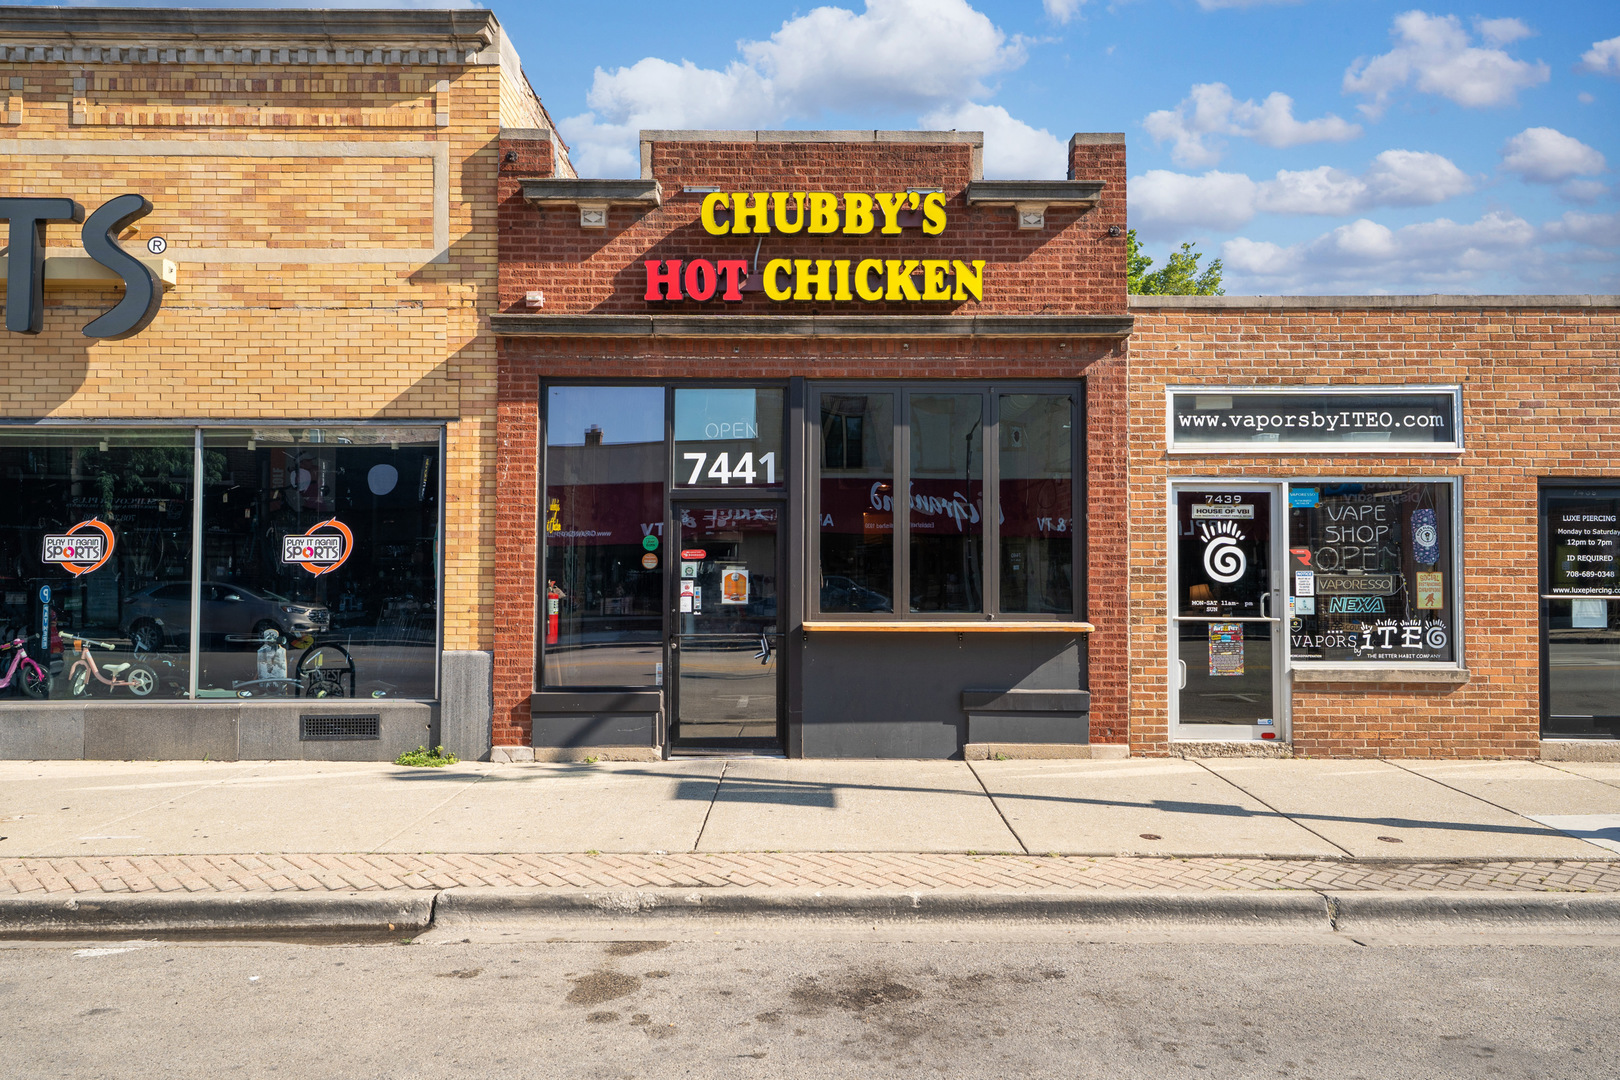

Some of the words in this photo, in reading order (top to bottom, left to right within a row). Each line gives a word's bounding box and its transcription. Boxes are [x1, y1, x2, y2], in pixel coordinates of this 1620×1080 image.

[701, 191, 947, 236] CHUBBY'S
[644, 259, 749, 302] HOT
[763, 258, 987, 302] CHICKEN
[1178, 411, 1445, 431] www.vaporsbyITEO.com
[705, 422, 758, 438] OPEN
[683, 452, 775, 484] 7441
[1205, 495, 1242, 504] 7439
[1327, 504, 1386, 521] VAPE
[1325, 525, 1389, 543] SHOP
[1557, 528, 1582, 536] Monday
[1592, 528, 1620, 536] Saturday
[47, 546, 100, 559] SPORTS
[286, 546, 339, 559] SPORTS
[1577, 555, 1614, 563] REQUIRED
[1319, 579, 1391, 590] VAPORESSO
[1419, 574, 1440, 582] SOCIAL
[1329, 596, 1386, 613] NEXA
[1291, 635, 1358, 648] VAPORS
[1353, 646, 1362, 657] by
